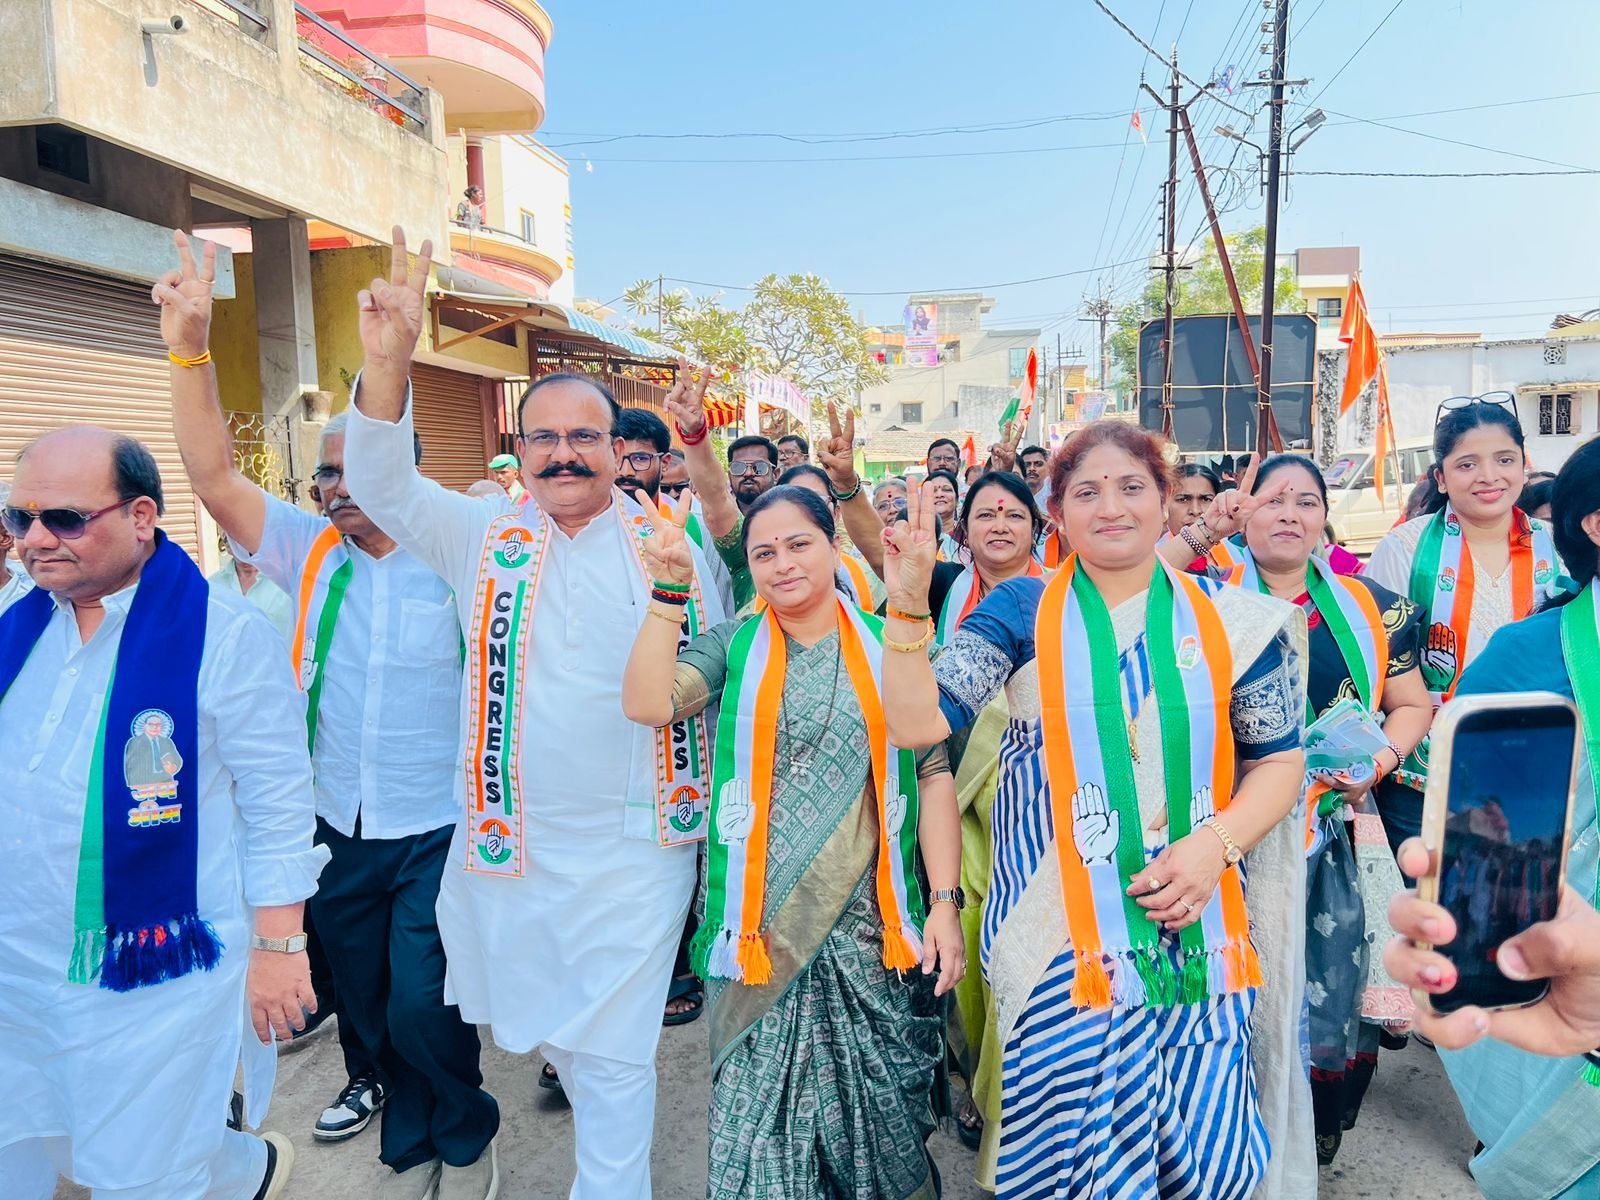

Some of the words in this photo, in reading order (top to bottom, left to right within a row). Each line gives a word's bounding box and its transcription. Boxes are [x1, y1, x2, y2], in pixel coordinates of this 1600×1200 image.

[484, 591, 513, 804] CONGRESS
[131, 781, 179, 801] जय
[128, 800, 182, 827] भीम
